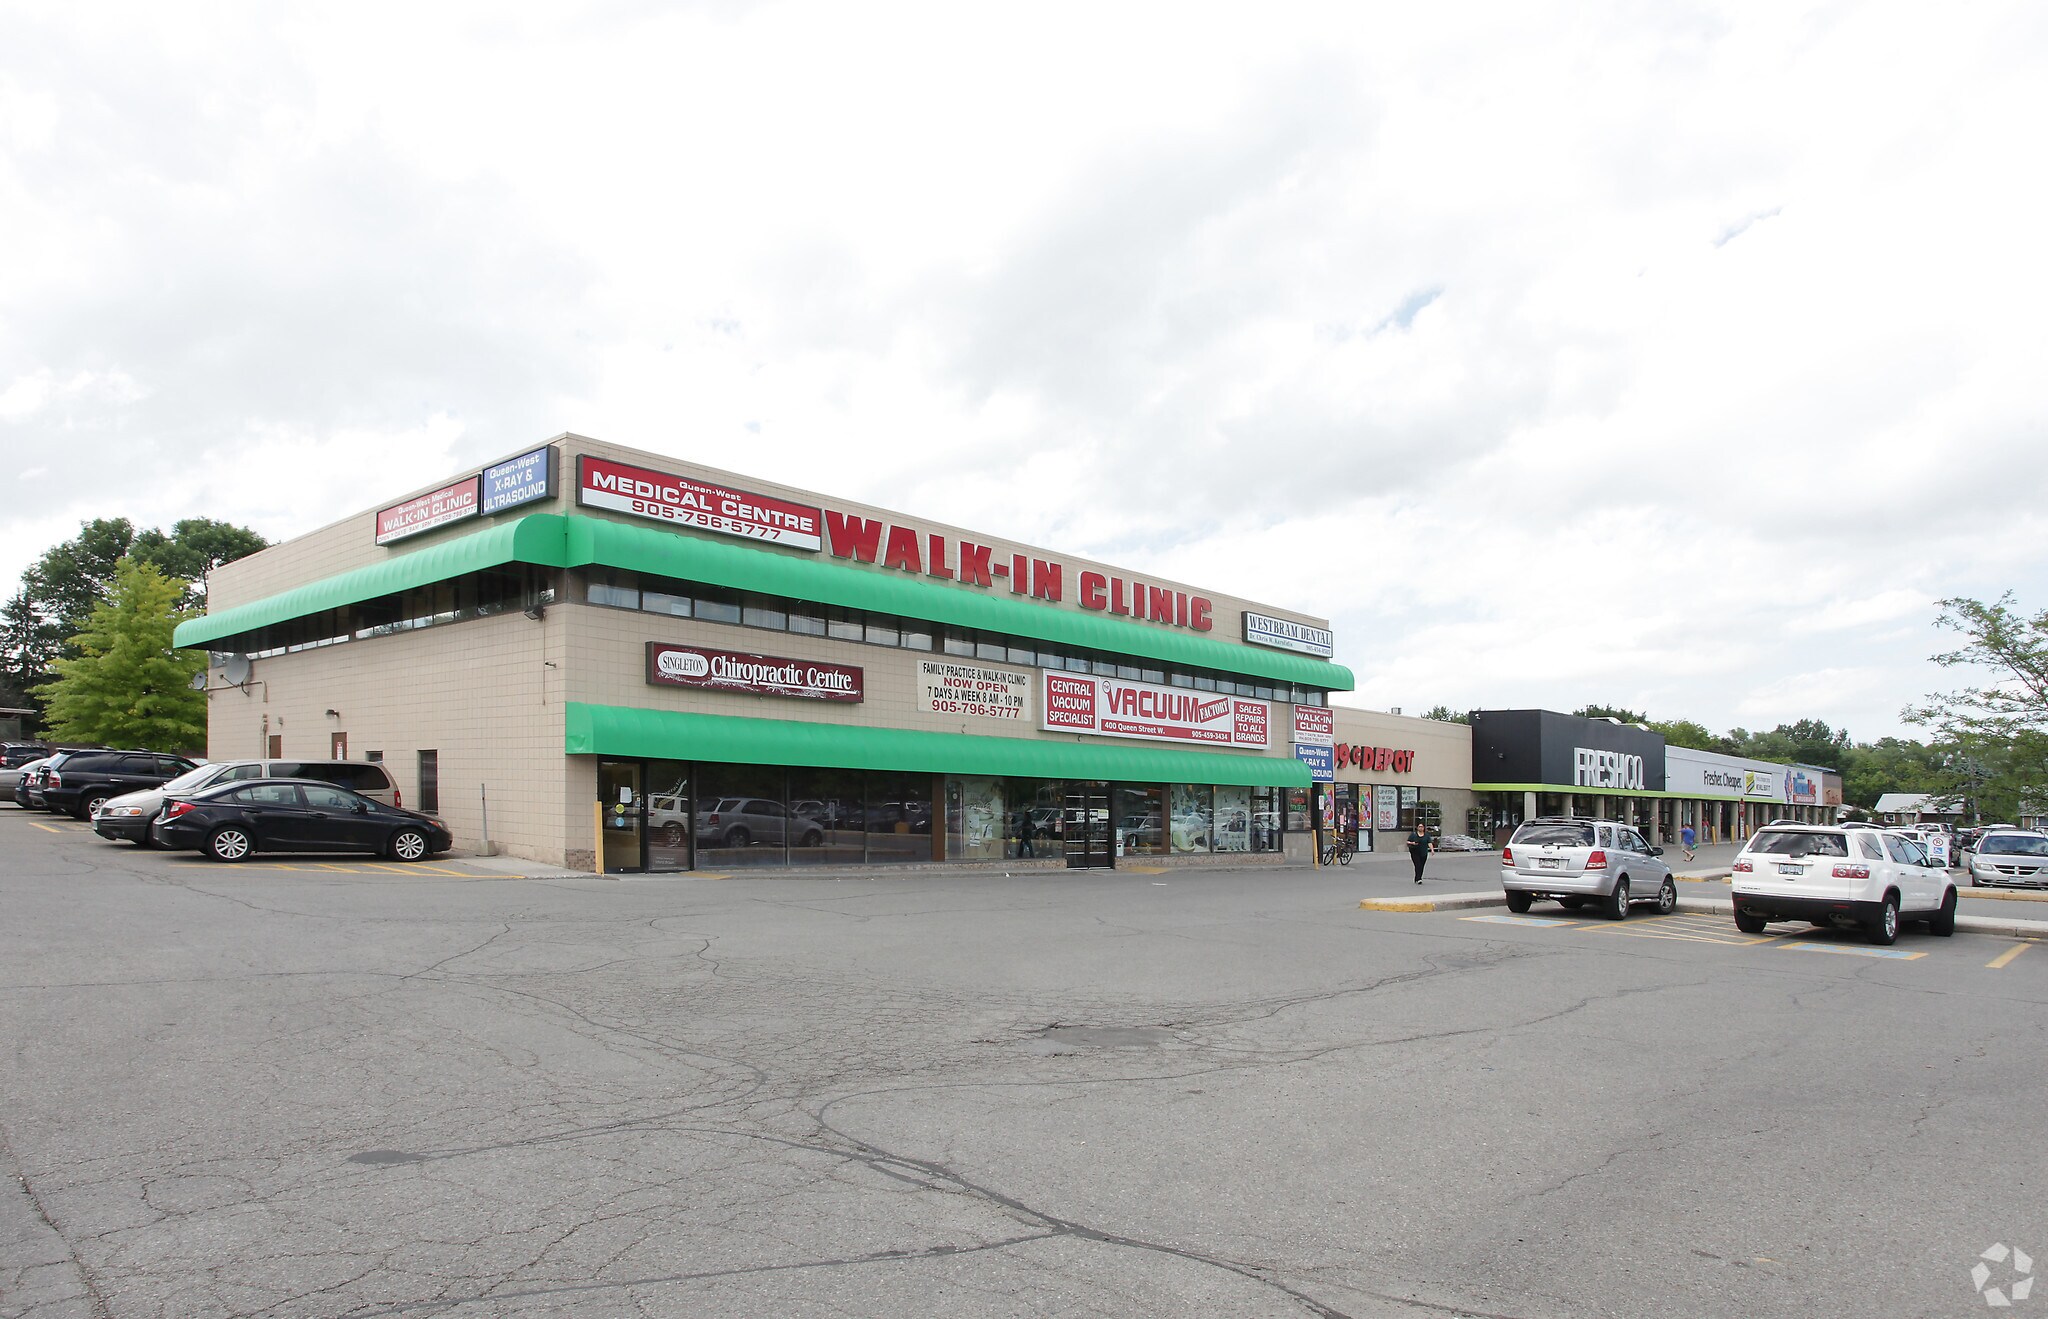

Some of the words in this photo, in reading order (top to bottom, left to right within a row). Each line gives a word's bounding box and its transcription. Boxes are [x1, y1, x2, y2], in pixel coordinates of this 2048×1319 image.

[490, 454, 539, 479] Queen-West
[526, 468, 532, 482] &
[432, 489, 454, 502] Medical
[484, 481, 546, 510] ULTRASOUND
[679, 482, 742, 500] Queen-West
[432, 492, 472, 516] CLINIC
[592, 470, 713, 511] MEDICAL
[721, 500, 814, 532] CENTRE
[631, 500, 782, 540] 905-796-5777
[825, 509, 1062, 602] WALK-IN
[1078, 570, 1213, 632] CLINIC
[1249, 615, 1298, 638] WESTBRAM
[1300, 628, 1330, 646] DENTAL
[662, 655, 704, 672] SINGLETON
[710, 656, 804, 686] Chiropractic
[806, 667, 852, 690] Centre
[923, 662, 945, 676] FAMILY
[946, 666, 976, 679] PRACTICE
[976, 670, 980, 680] &
[982, 670, 1006, 684] WALK-IN
[1008, 674, 1026, 686] CLINIC
[944, 678, 972, 688] NOW
[976, 682, 1008, 693] OPEN
[1050, 680, 1092, 696] CENTRAL
[928, 686, 932, 698] 7
[934, 687, 952, 700] DAYS
[954, 689, 960, 700] A
[960, 690, 980, 702] WEEK
[982, 692, 986, 703] 8
[988, 693, 998, 704] AM
[1004, 695, 1012, 706] 10
[1014, 696, 1024, 707] PM
[1052, 696, 1090, 712] VACUUM
[932, 699, 1020, 718] 905-796-5777
[1107, 688, 1200, 724] VACUUM
[1200, 700, 1228, 720] FACTORY
[1238, 704, 1262, 714] SALES
[1049, 710, 1094, 726] SPECIALIST
[1235, 714, 1266, 724] REPAIRS
[1104, 722, 1117, 730] 400
[1118, 722, 1137, 732] Queen
[1192, 730, 1228, 740] 905-459-3434
[1238, 724, 1248, 732] TO
[1250, 724, 1263, 734] ALL
[1300, 722, 1328, 732] CLINIC
[1236, 732, 1265, 743] BRANDS
[1321, 759, 1326, 767] &
[1360, 746, 1414, 773] DEPOT
